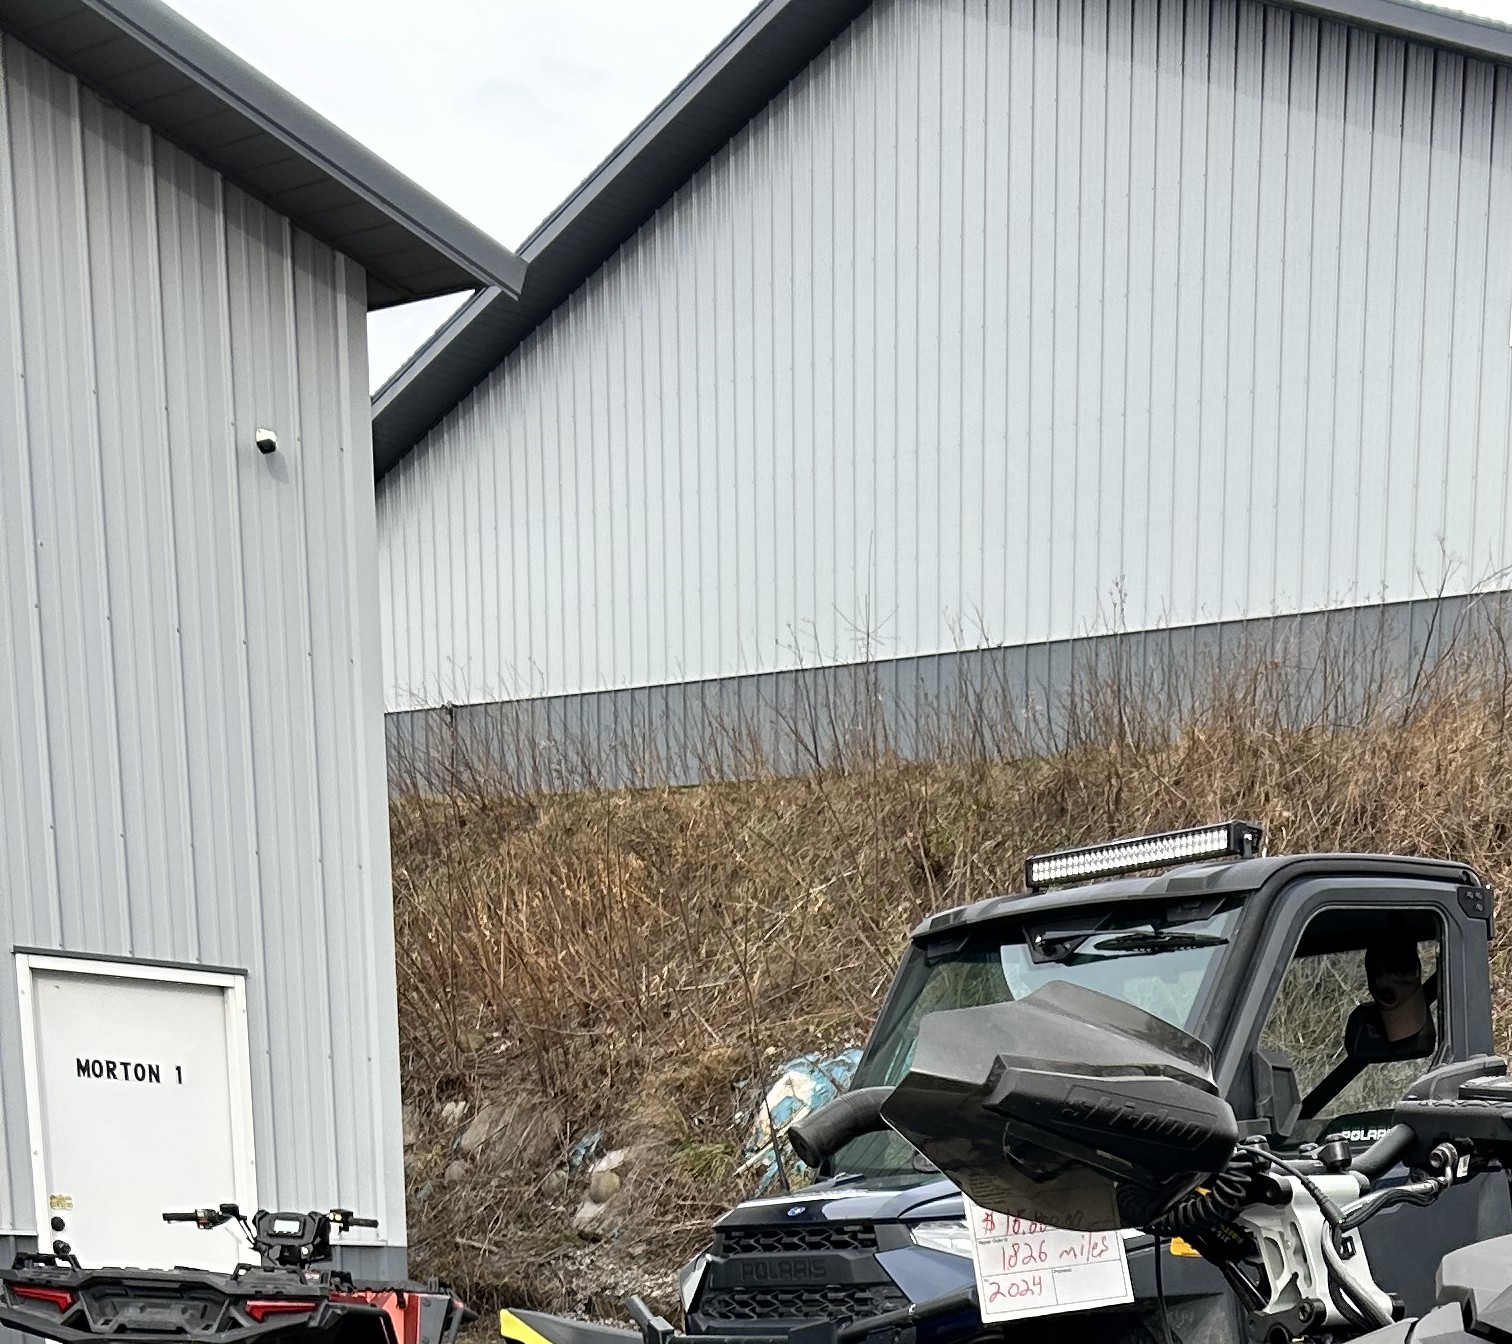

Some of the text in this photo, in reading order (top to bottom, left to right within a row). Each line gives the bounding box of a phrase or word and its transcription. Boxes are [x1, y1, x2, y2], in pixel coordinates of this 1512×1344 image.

[76, 1058, 182, 1085] MORTON 1
[1341, 1128, 1391, 1141] POLAR
[982, 1211, 996, 1236] $
[1002, 1234, 1109, 1271] 1826 miles
[741, 1259, 827, 1281] POLARIS
[988, 1275, 1044, 1303] 2024
